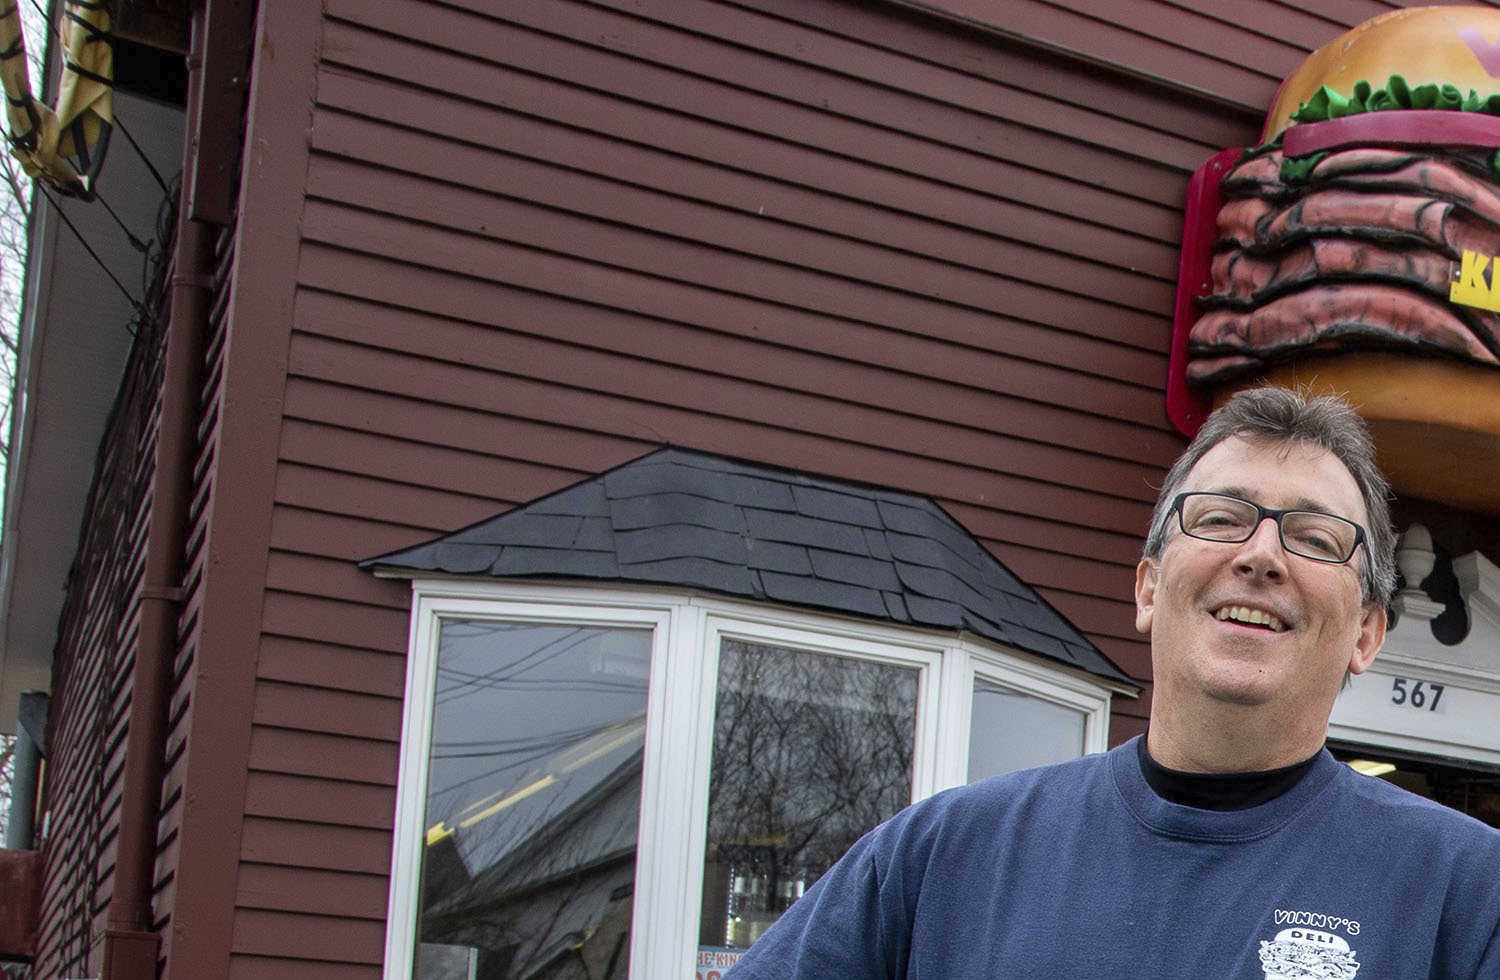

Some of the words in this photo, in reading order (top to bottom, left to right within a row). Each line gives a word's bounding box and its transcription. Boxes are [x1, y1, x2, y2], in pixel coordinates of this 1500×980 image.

[1391, 678, 1445, 711] 567
[1274, 909, 1361, 935] VINNY'S
[1291, 931, 1334, 944] DELI
[716, 952, 743, 967] KIN
